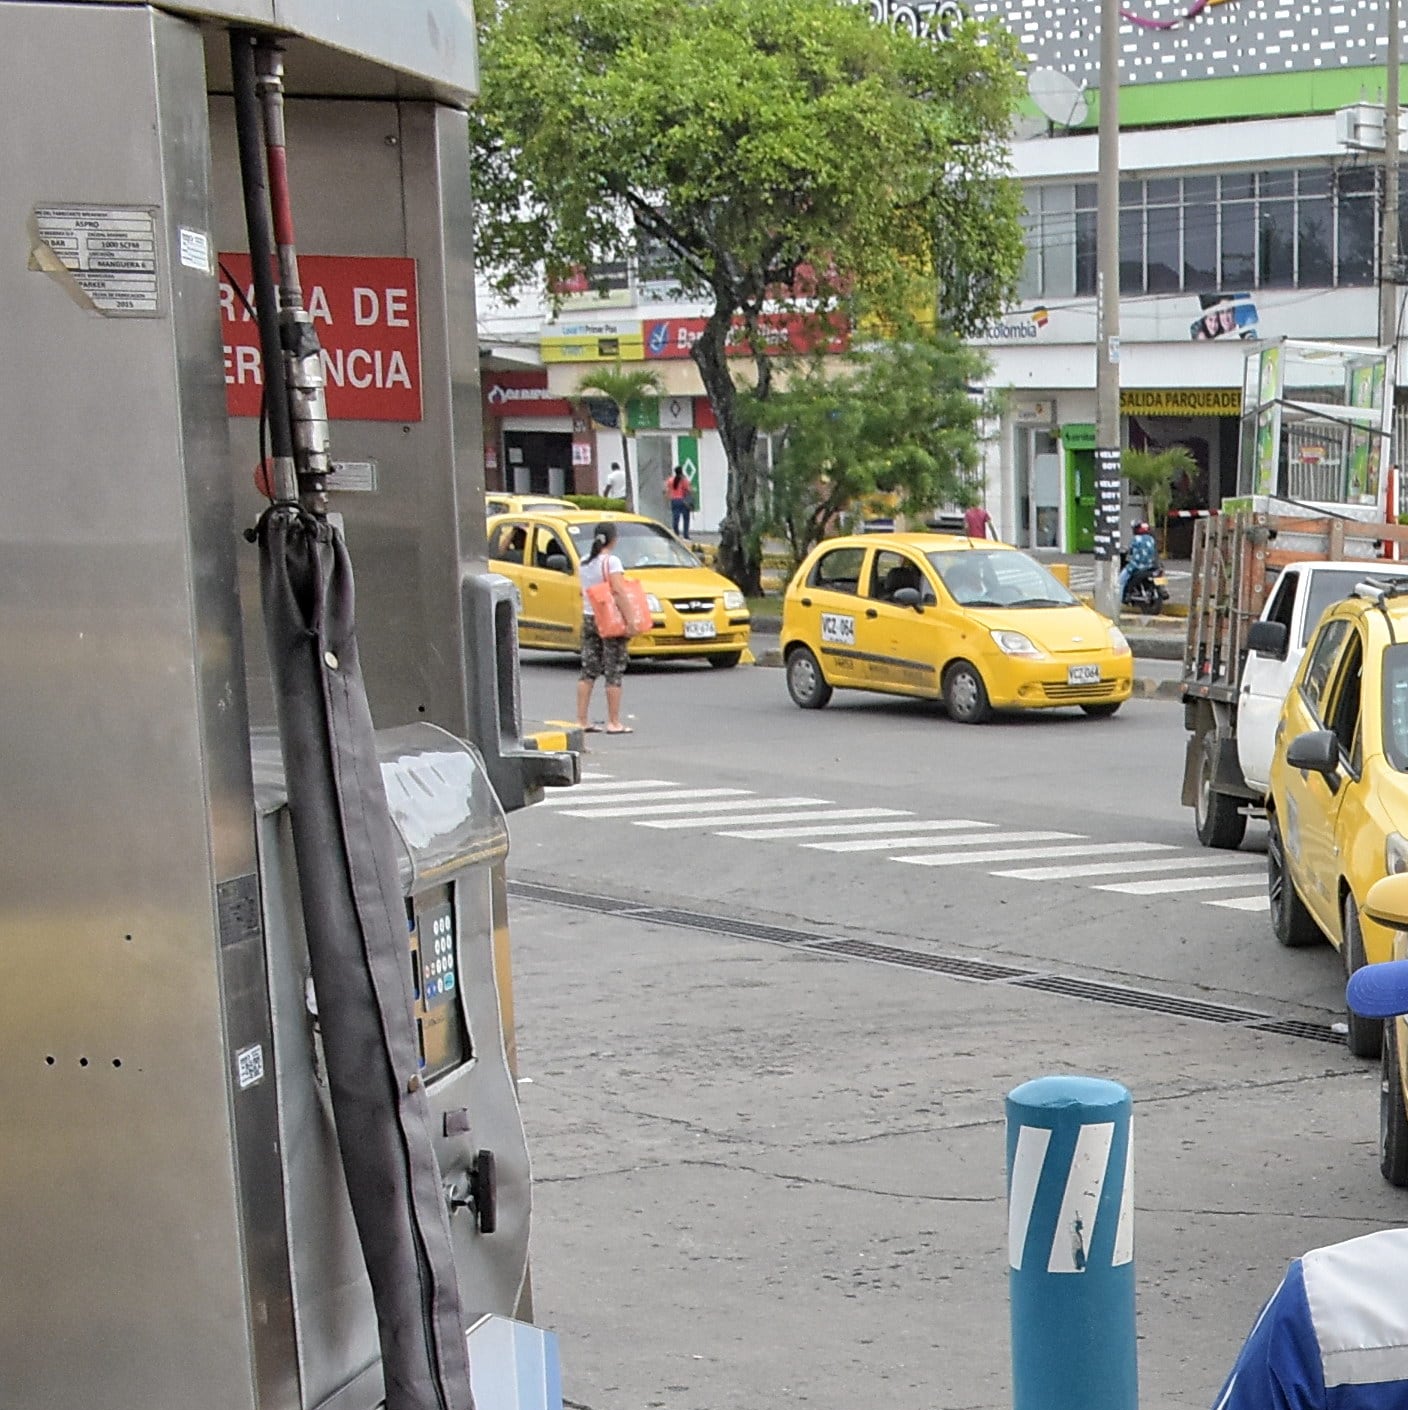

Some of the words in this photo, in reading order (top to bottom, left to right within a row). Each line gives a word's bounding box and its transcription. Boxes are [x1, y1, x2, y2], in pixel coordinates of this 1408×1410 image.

[75, 220, 100, 228] ASPRO
[51, 239, 66, 247] BAR
[97, 260, 140, 269] MANGUERA
[353, 287, 410, 328] DE
[222, 345, 412, 389] ERNCIA
[1120, 392, 1162, 407] SALIDA
